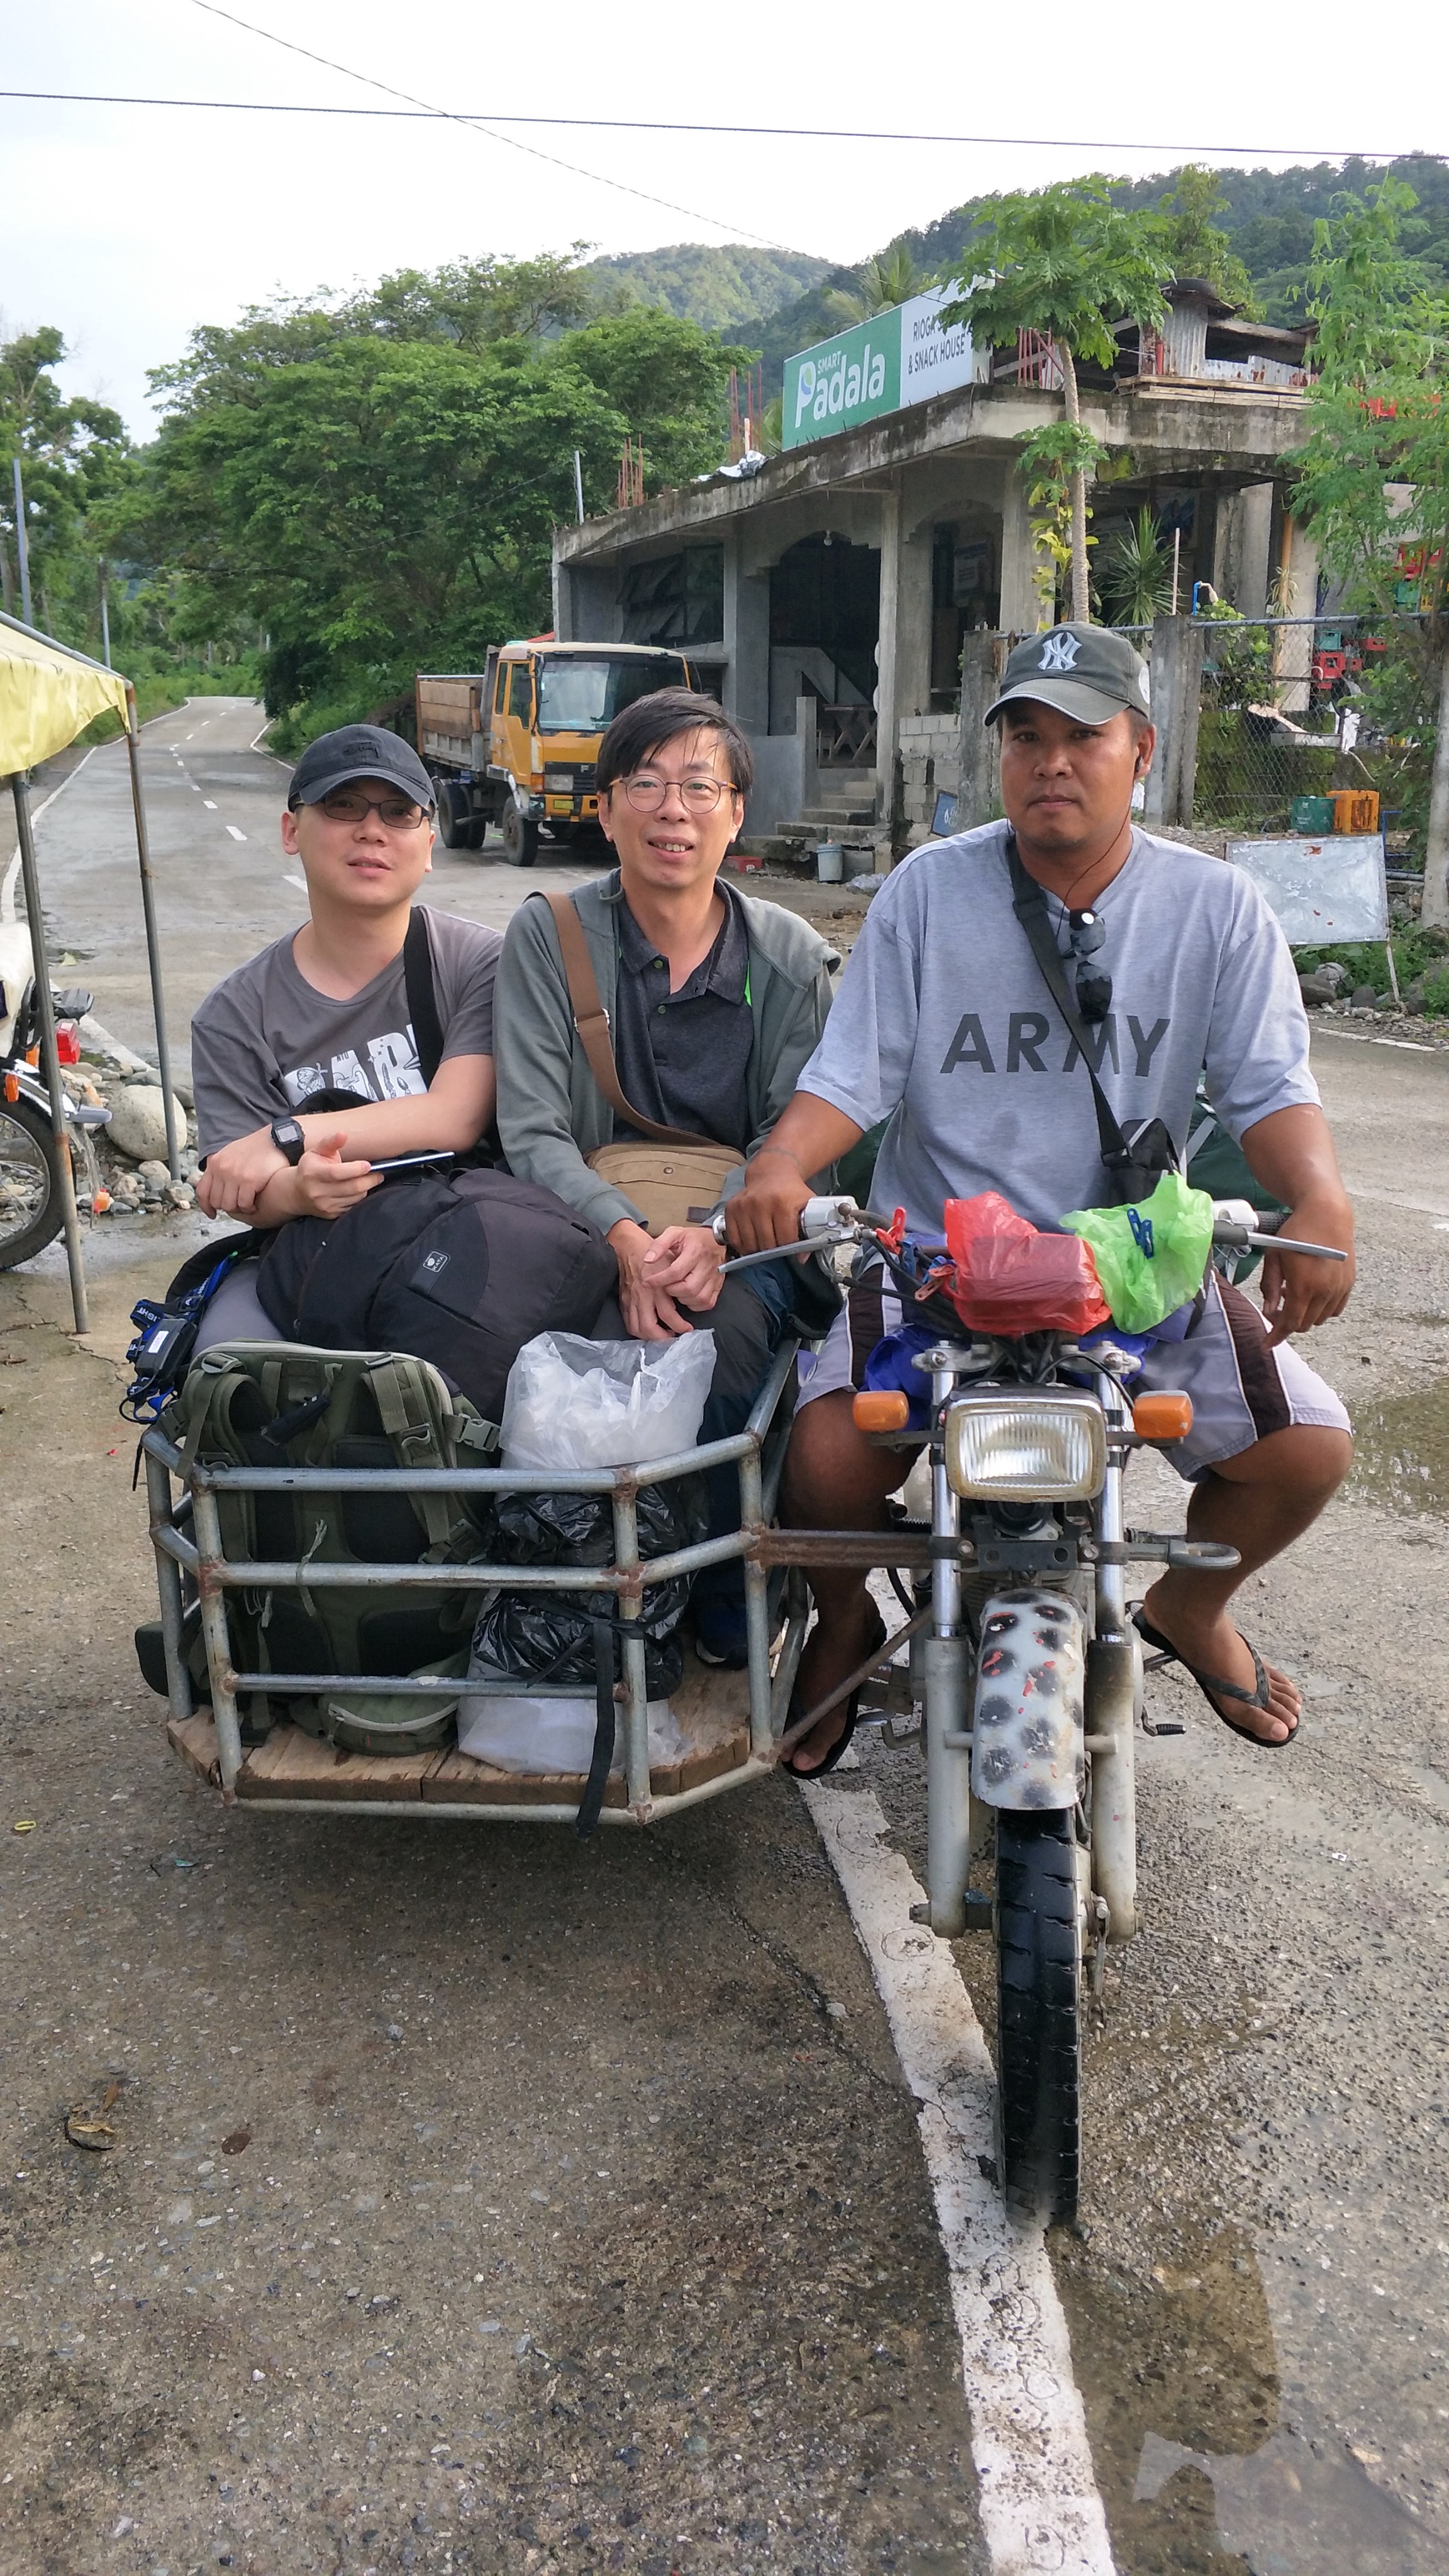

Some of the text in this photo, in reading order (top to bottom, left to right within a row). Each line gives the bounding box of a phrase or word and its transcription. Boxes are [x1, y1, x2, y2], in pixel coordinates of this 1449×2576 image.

[818, 350, 841, 374] SMART
[908, 333, 965, 375] & SNACK HOUSE
[795, 343, 886, 428] Padala
[1038, 631, 1083, 671] NY
[940, 1012, 1171, 1077] ARMY
[432, 1257, 444, 1270] KATA
